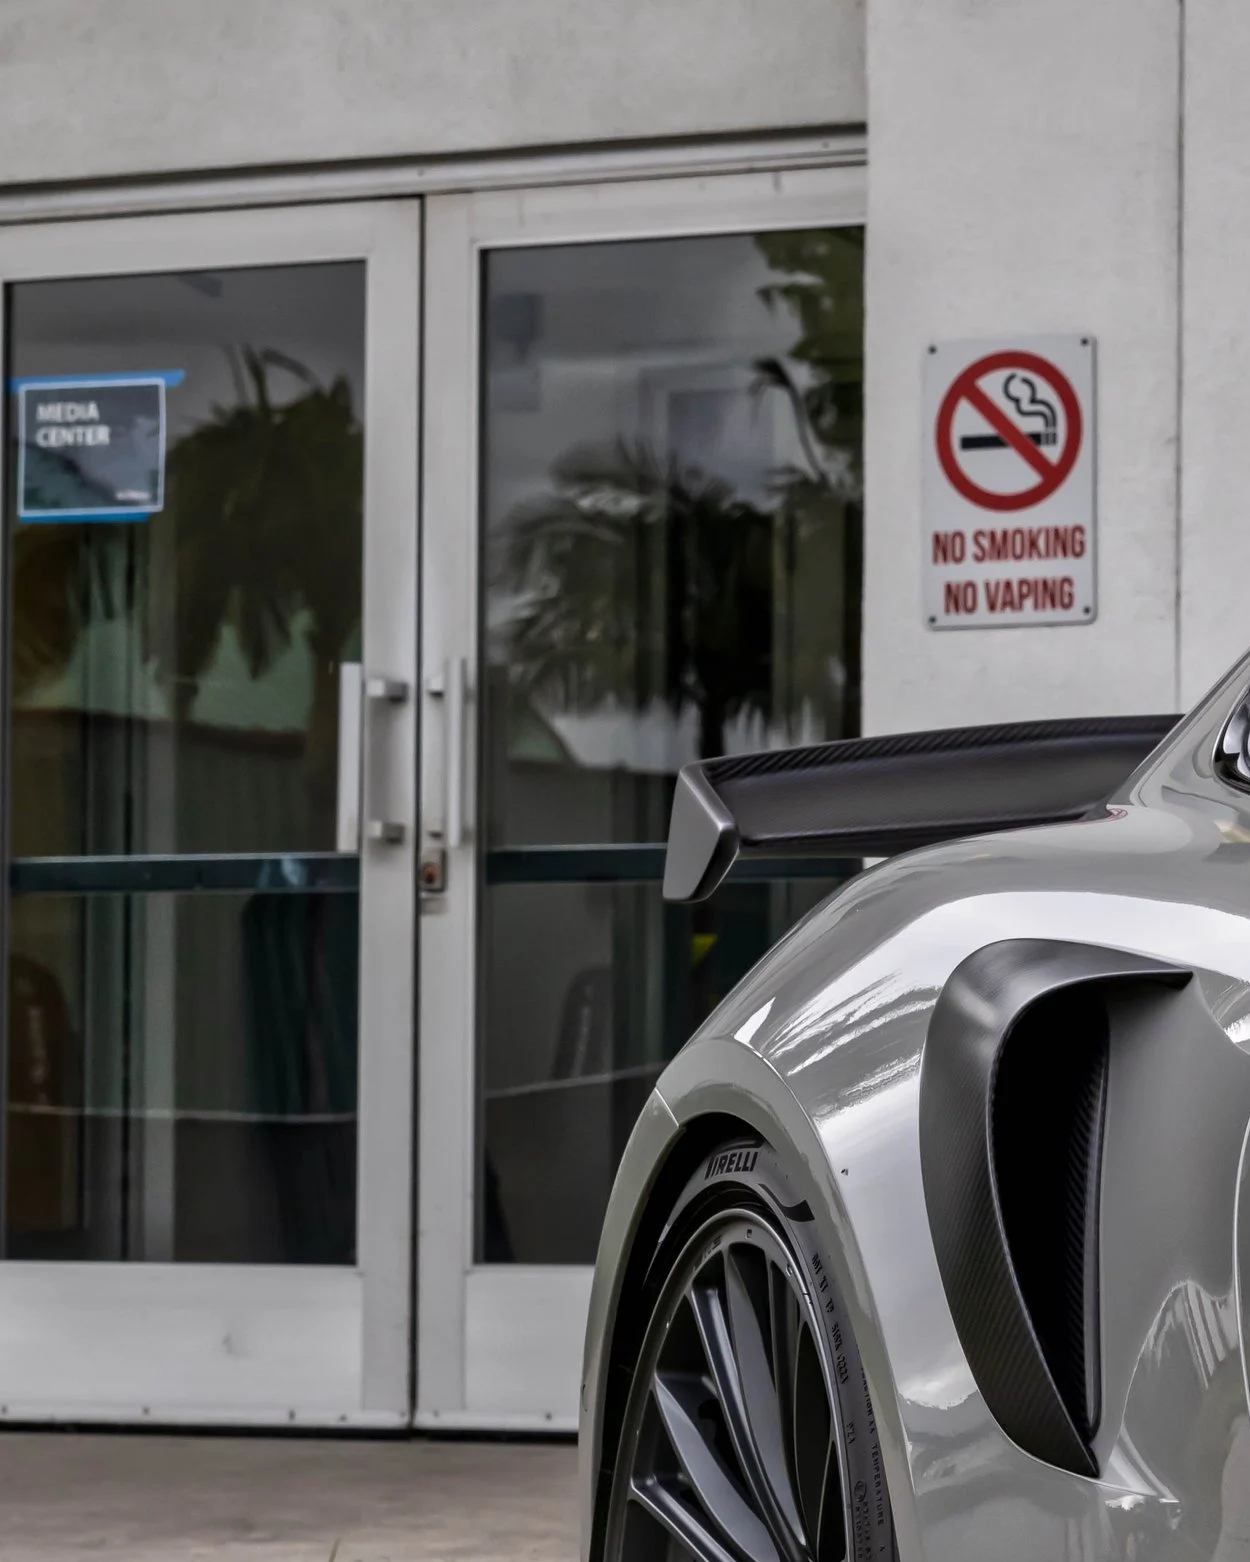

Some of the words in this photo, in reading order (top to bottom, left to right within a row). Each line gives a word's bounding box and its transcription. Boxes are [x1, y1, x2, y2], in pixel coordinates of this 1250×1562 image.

[36, 401, 100, 423] MEDIA
[35, 424, 110, 448] CENTER
[932, 530, 966, 565] NO
[973, 524, 1086, 563] SMOKING
[944, 580, 978, 615] NO
[984, 576, 1075, 613] VAPING
